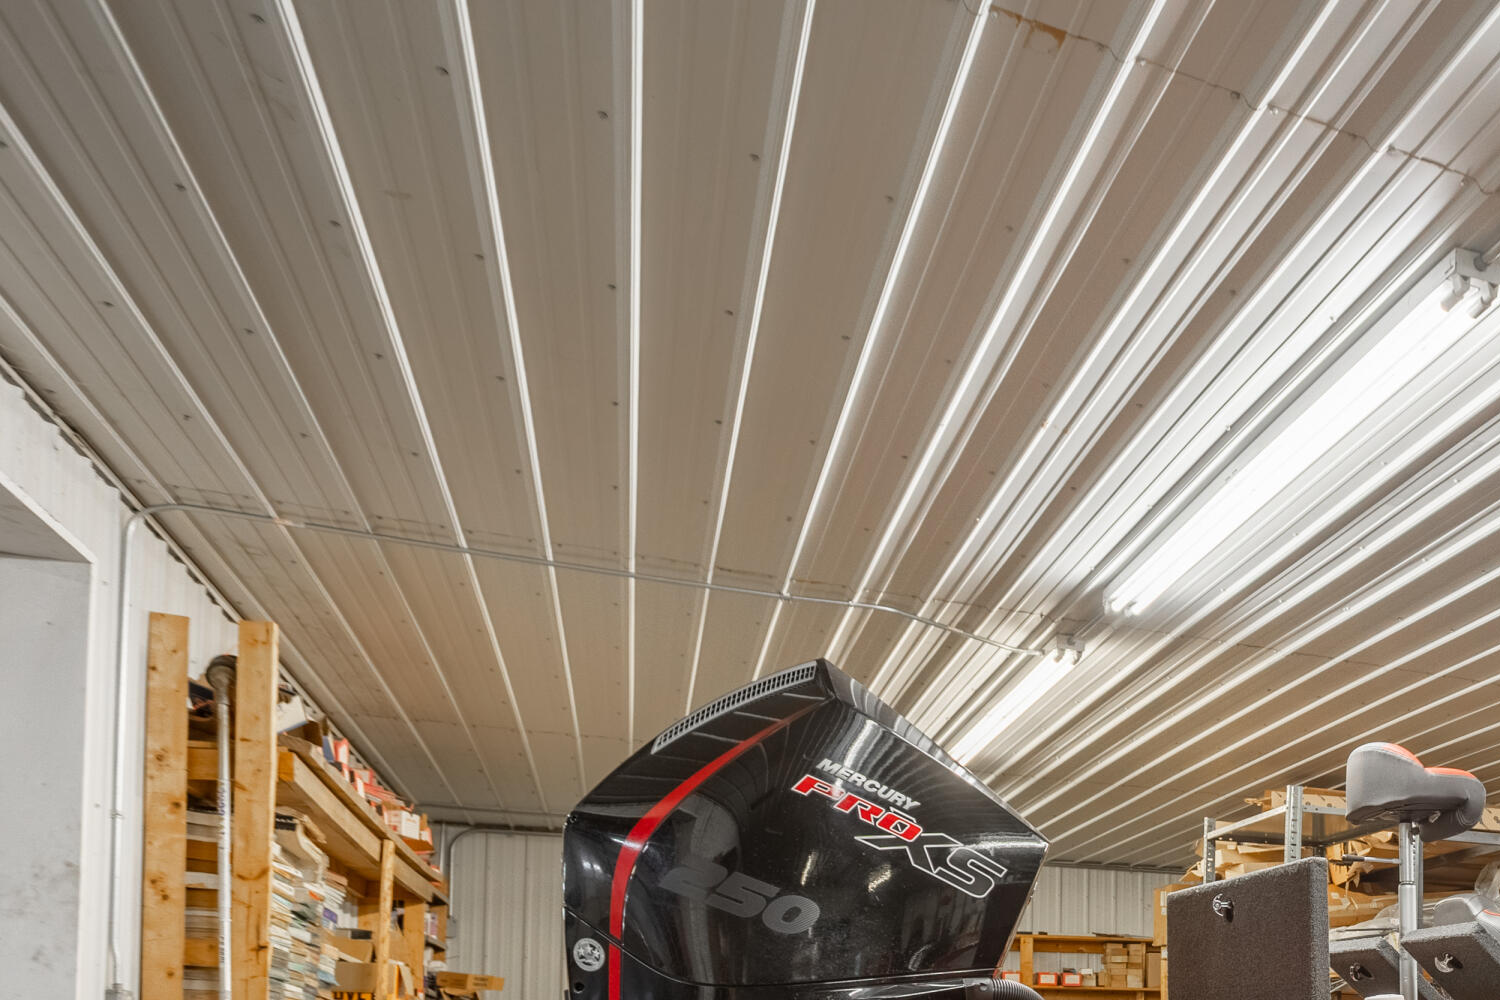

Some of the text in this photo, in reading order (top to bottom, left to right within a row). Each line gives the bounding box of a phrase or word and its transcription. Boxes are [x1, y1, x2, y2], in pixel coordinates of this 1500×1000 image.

[816, 758, 921, 810] MERCURY
[791, 774, 1008, 898] PRO XS
[658, 862, 821, 934] 250
